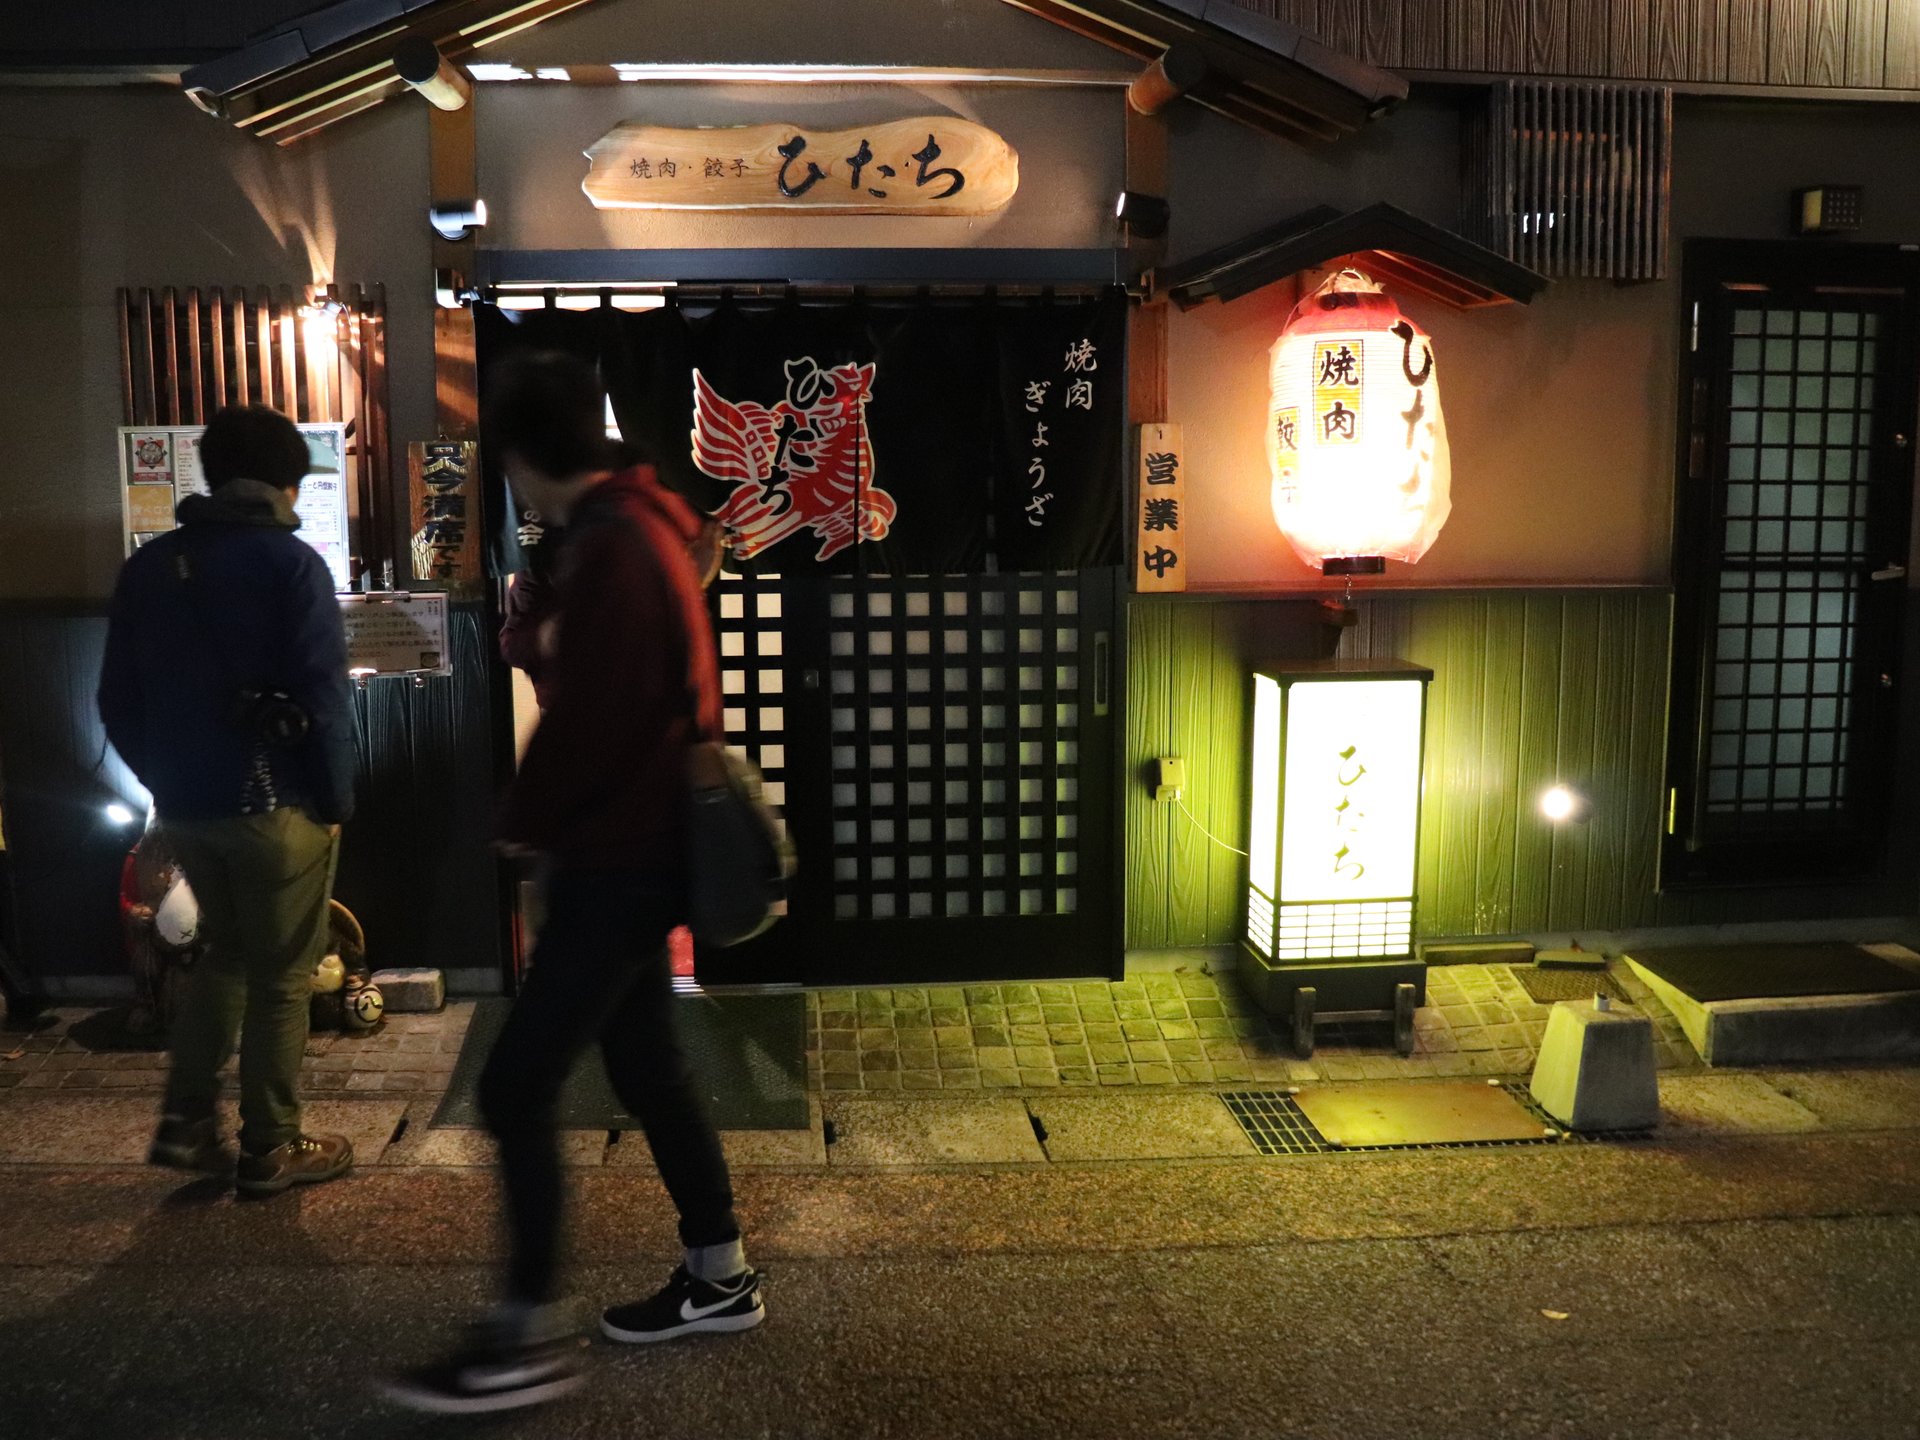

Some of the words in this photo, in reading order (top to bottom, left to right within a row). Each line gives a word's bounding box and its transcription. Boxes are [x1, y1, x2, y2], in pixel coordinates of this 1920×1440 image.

[777, 133, 965, 200] ひたち
[757, 355, 836, 517] ひたち
[1064, 338, 1098, 411] 焼肉
[1317, 345, 1360, 441] 焼肉
[1388, 319, 1435, 518] ひたち
[421, 443, 467, 577] 只今満席です
[1024, 380, 1055, 528] ぎょうざ
[1143, 452, 1180, 580] 営業中
[1332, 743, 1368, 881] ひたち
